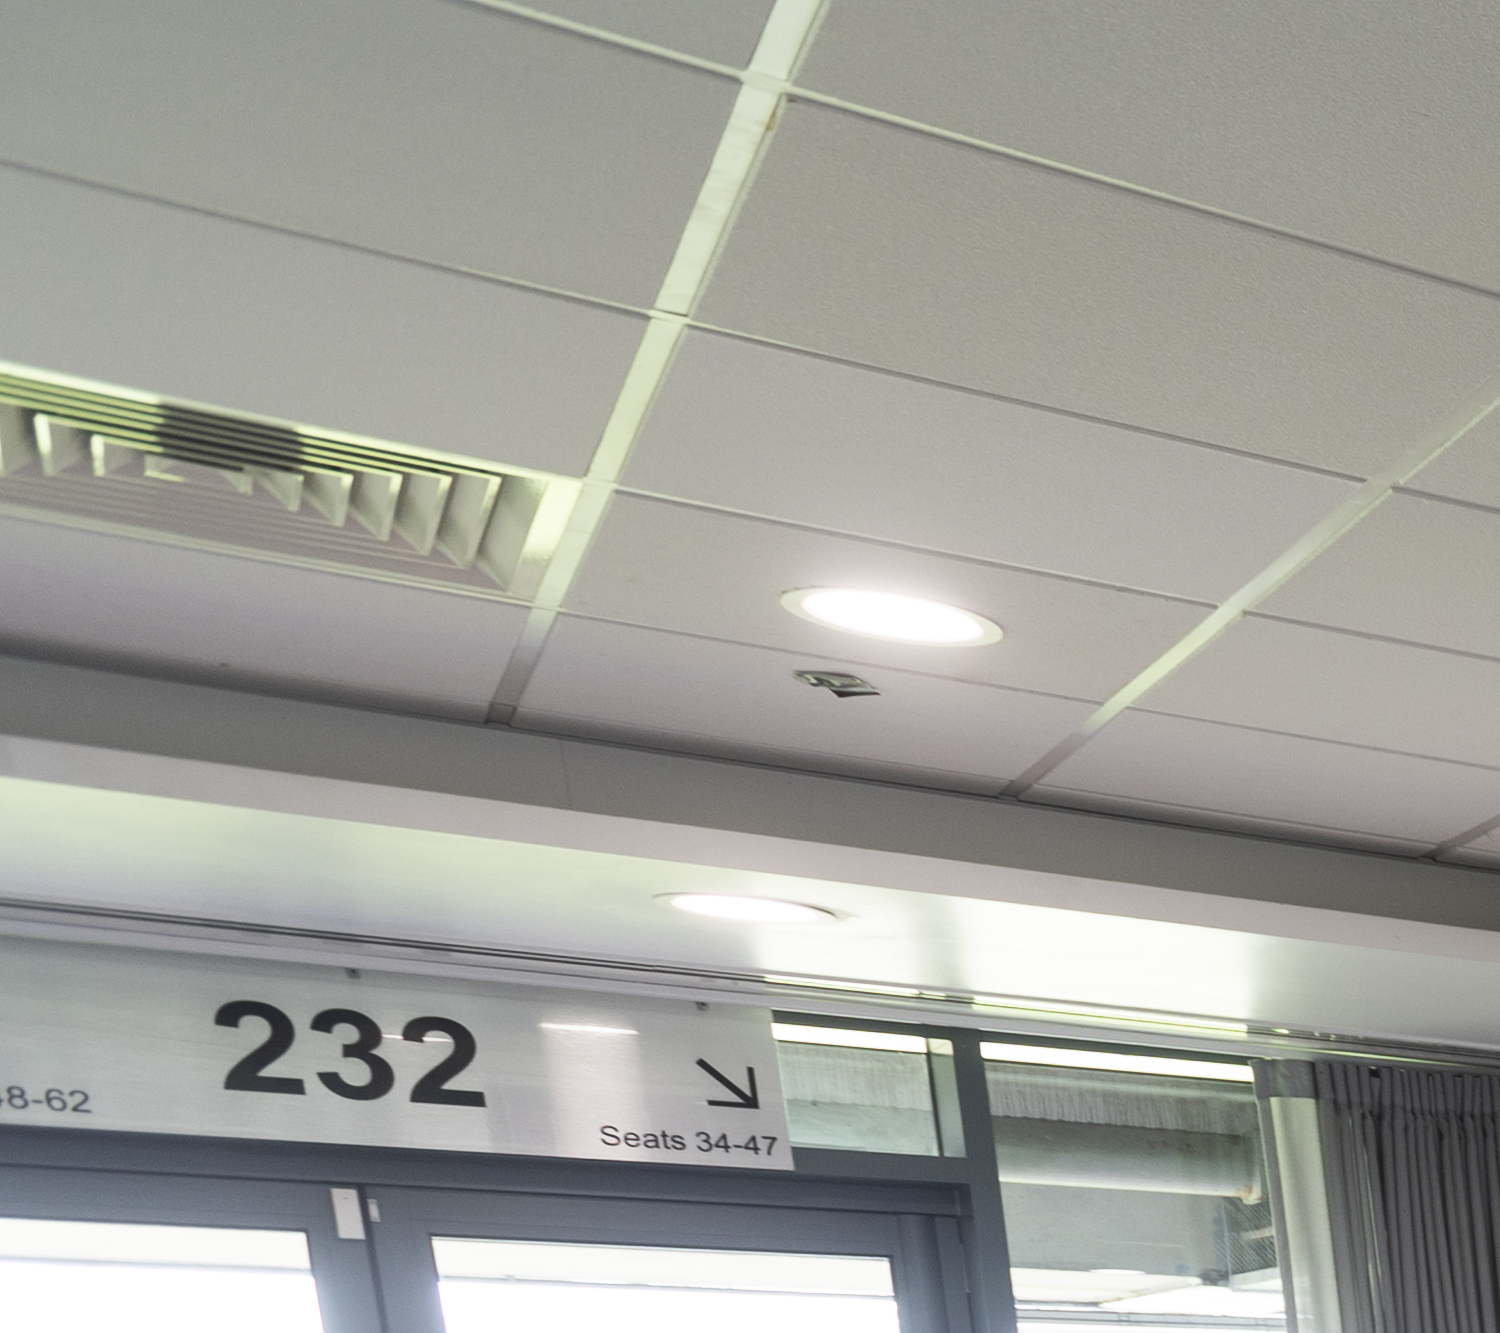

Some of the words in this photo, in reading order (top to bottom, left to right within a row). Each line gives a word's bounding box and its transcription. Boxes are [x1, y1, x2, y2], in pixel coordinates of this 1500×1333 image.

[214, 1000, 487, 1108] 232
[0, 1085, 92, 1113] 8-62
[600, 1125, 686, 1151] Seats
[696, 1131, 777, 1156] 34-47
